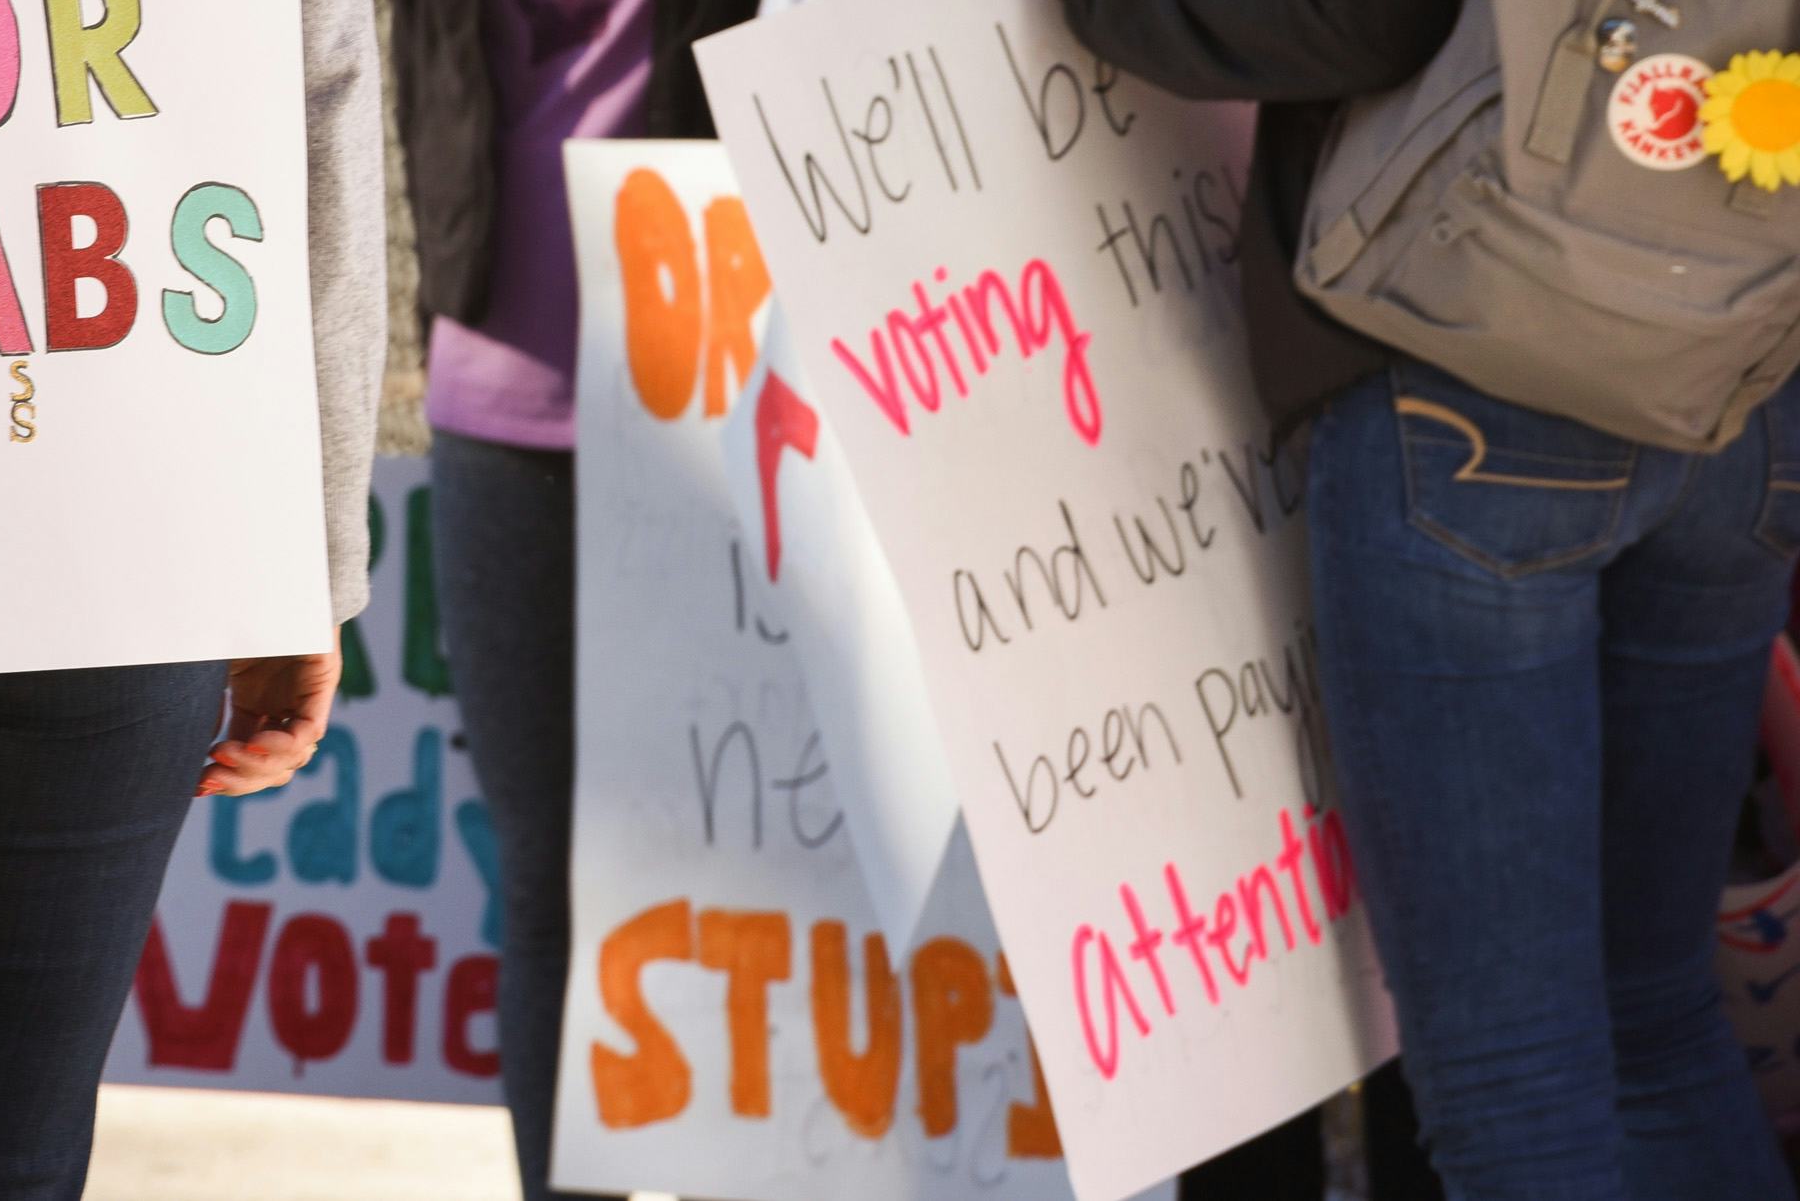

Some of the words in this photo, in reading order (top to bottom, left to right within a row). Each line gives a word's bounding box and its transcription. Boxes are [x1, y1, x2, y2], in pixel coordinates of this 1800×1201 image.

[751, 45, 984, 244] We'll
[995, 21, 1137, 161] be
[830, 257, 1102, 448] voting
[952, 498, 1109, 654] and
[993, 700, 1184, 835] been
[131, 900, 503, 1078] Vote
[1070, 801, 1354, 1080] attentio
